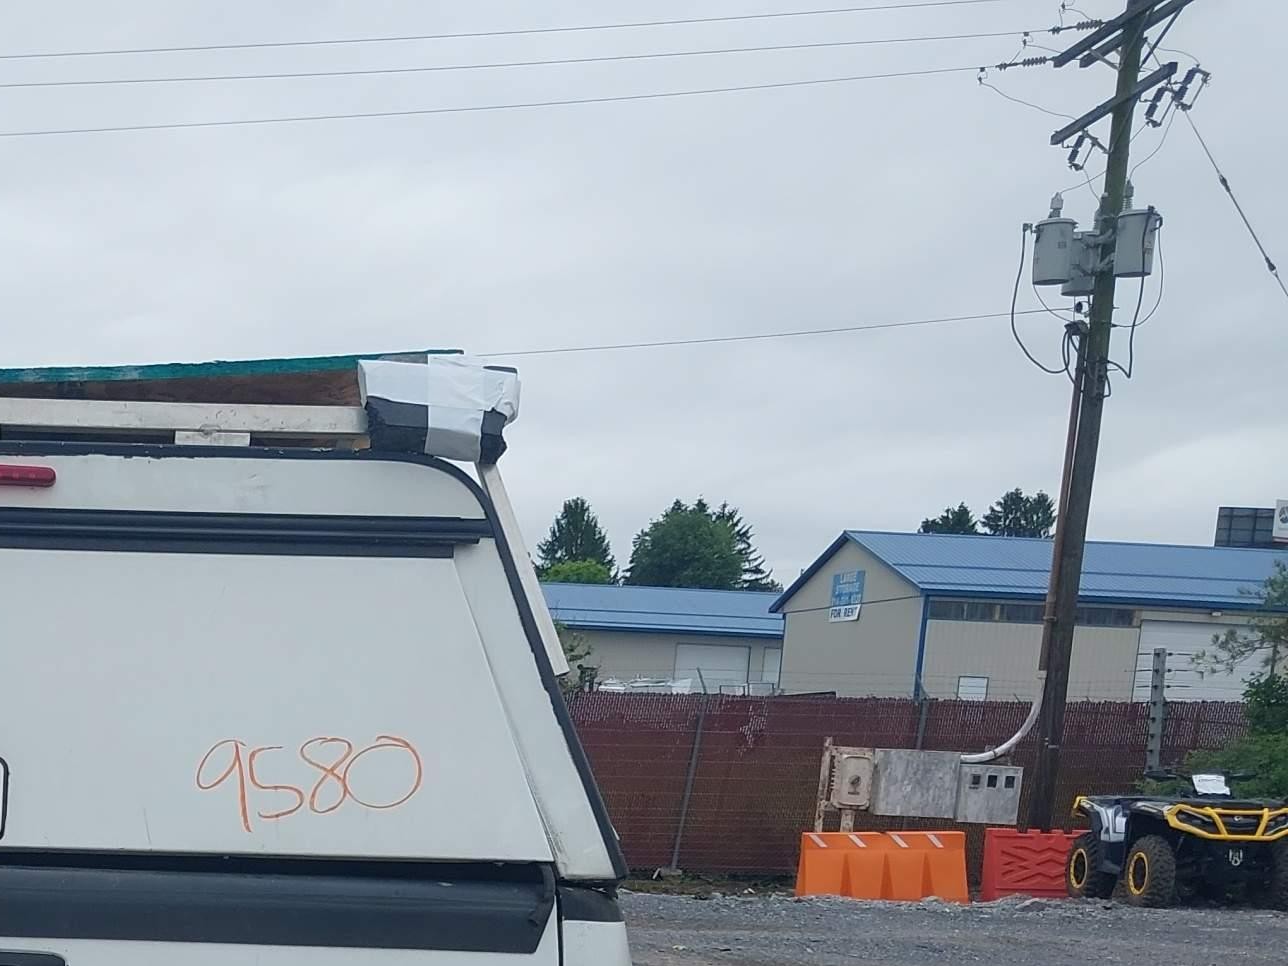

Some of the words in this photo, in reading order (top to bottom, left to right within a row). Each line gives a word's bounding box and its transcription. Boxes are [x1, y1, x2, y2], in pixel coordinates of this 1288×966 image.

[830, 608, 842, 619] FOR
[843, 606, 858, 617] RENT
[196, 735, 422, 832] 9580
